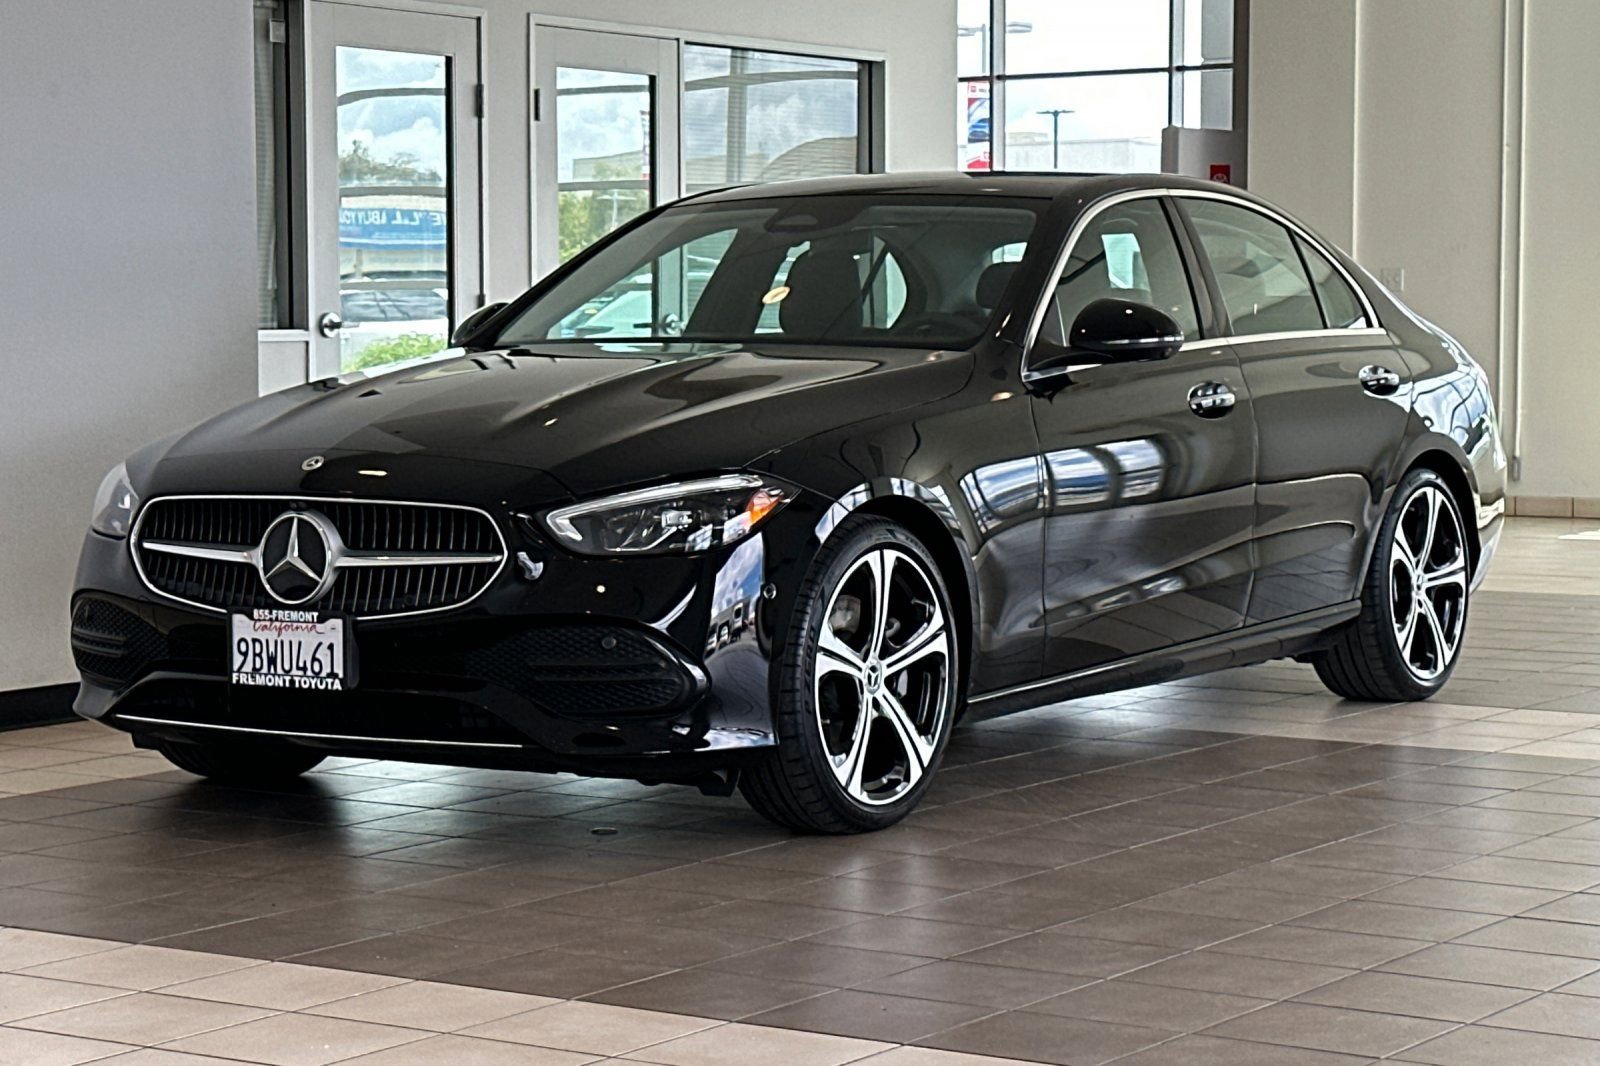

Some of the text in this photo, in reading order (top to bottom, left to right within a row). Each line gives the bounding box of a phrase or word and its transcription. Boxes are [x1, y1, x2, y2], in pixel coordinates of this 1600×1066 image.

[253, 609, 318, 622] 855-FREMONT
[253, 621, 325, 637] California
[236, 637, 339, 678] 9BWU461
[232, 673, 342, 690] FREMONT TOYOTA
